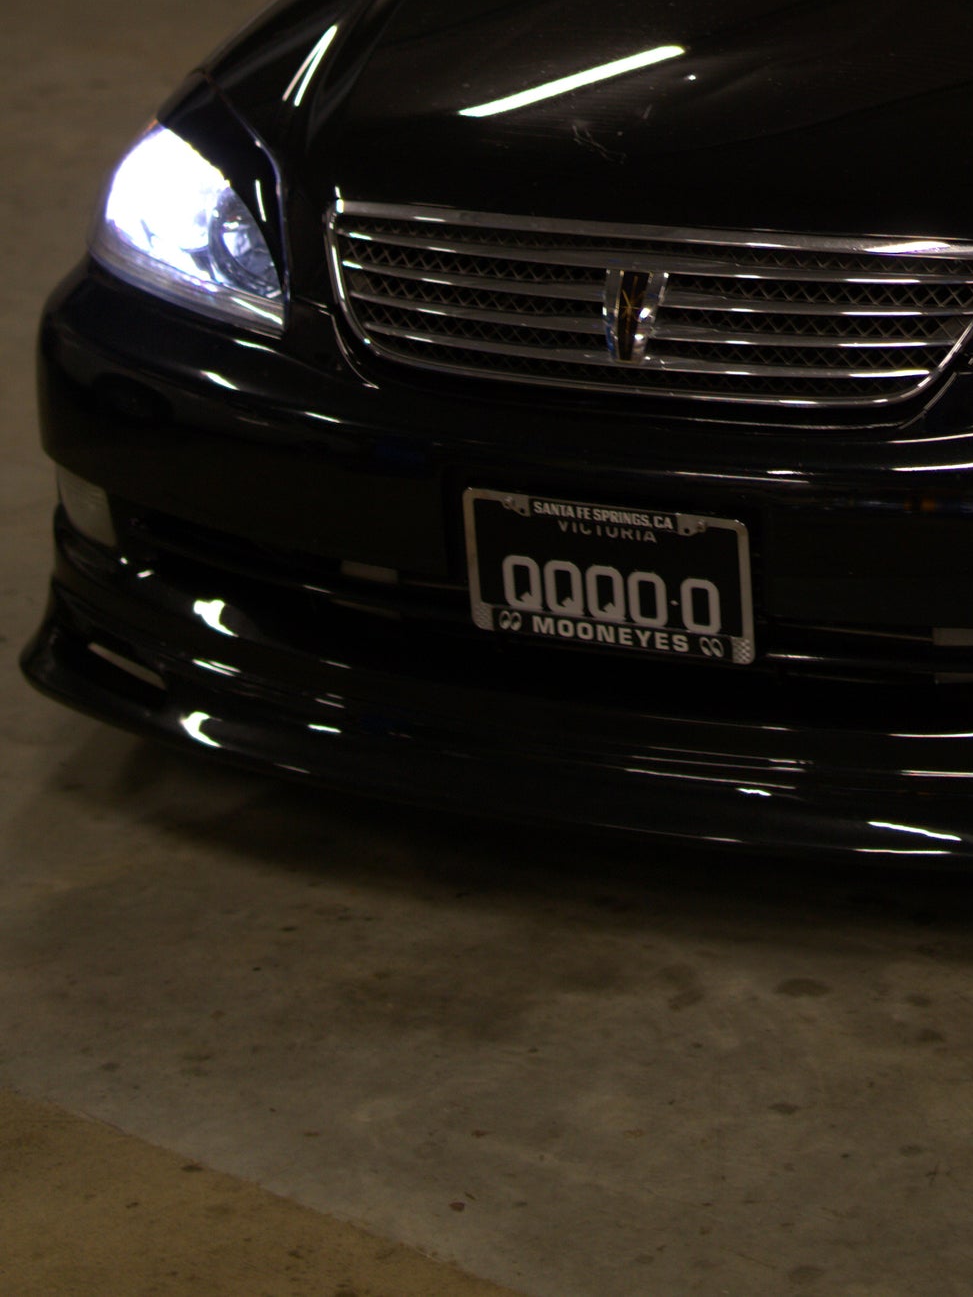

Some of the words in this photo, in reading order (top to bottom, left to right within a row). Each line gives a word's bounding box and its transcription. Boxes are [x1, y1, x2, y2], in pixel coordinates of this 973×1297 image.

[533, 501, 575, 519] SANTA
[575, 506, 591, 521] FE
[652, 515, 674, 531] CA
[531, 614, 690, 653] MOONEYES
